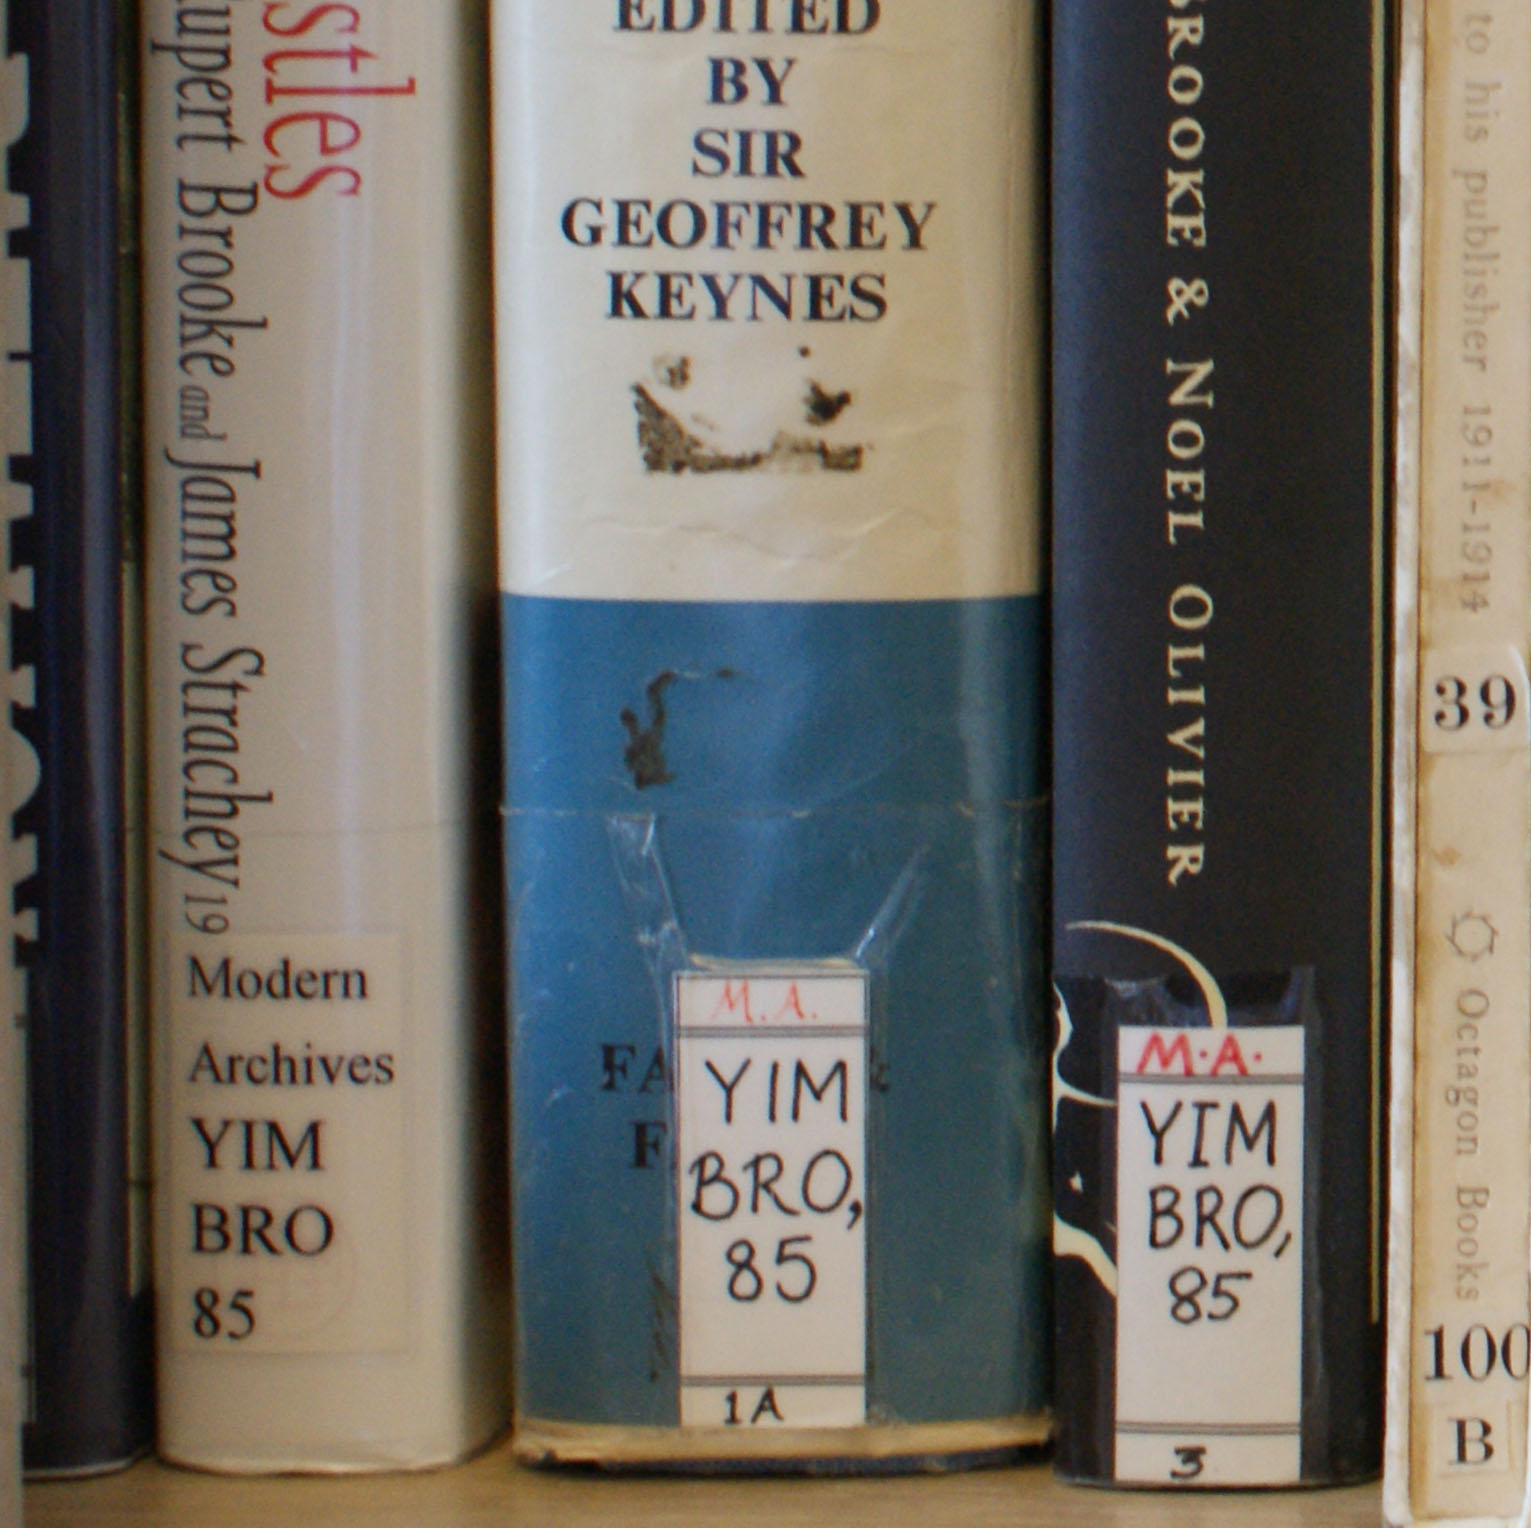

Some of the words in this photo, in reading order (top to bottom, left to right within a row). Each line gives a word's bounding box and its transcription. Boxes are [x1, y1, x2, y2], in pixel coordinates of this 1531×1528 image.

[704, 56, 799, 108] BY
[690, 127, 807, 180] SIR
[559, 197, 940, 252] GEOFFREY
[175, 178, 269, 379] Brooke
[604, 271, 890, 323] KEYNES
[1165, 275, 1212, 328] &
[178, 383, 228, 442] and
[1165, 357, 1216, 547] NOEL
[163, 455, 262, 619] James
[1432, 674, 1518, 733] 39
[1165, 582, 1216, 888] OLIVIER
[157, 643, 274, 891] Strachey
[186, 954, 371, 1003] Modern
[187, 1041, 398, 1089] Archives
[703, 1058, 851, 1127] YIM
[189, 1119, 327, 1174] YIM
[1139, 1099, 1279, 1170] YIM
[688, 1147, 866, 1231] BRO,
[189, 1203, 336, 1258] BRO
[1147, 1183, 1293, 1260] BRO,
[724, 1236, 820, 1305] 85
[1167, 1265, 1254, 1326] 85
[191, 1288, 259, 1341] 85
[1423, 1322, 1531, 1384] 100
[1447, 1416, 1496, 1468] B
